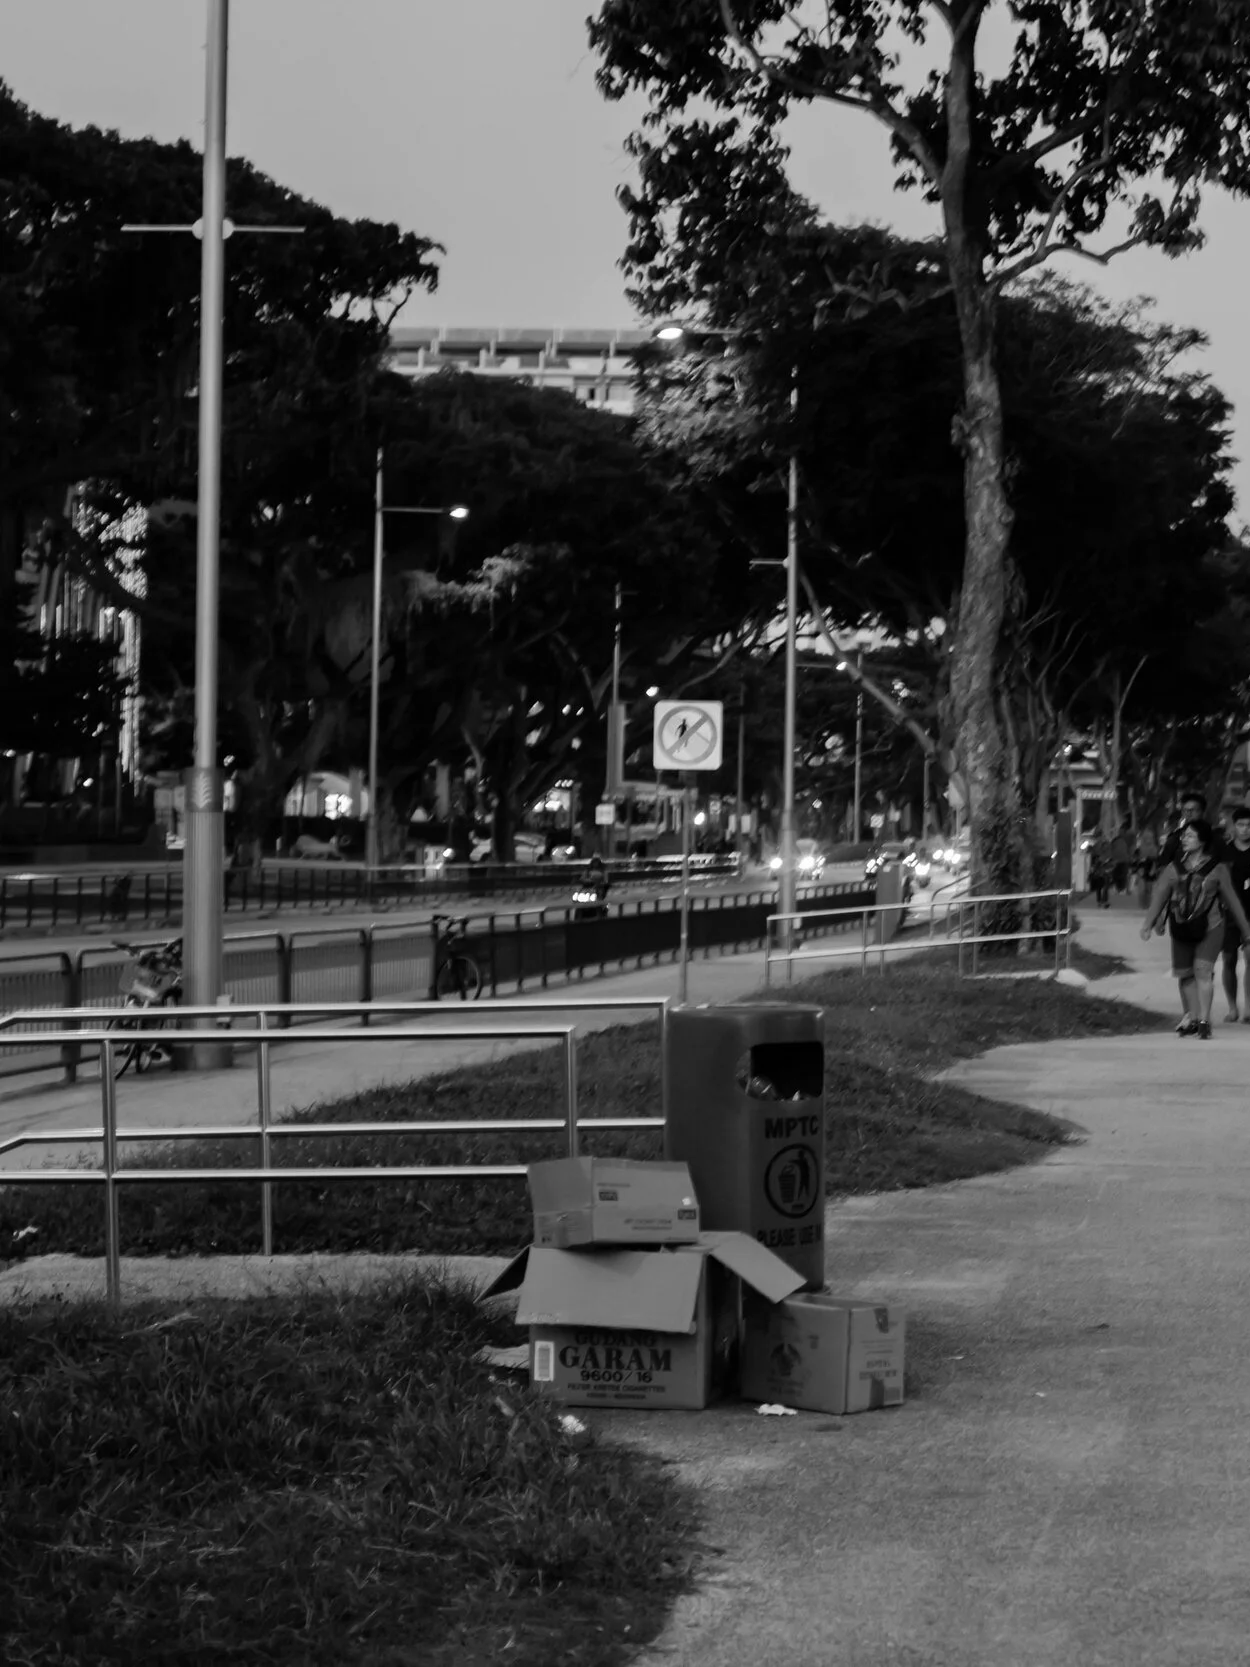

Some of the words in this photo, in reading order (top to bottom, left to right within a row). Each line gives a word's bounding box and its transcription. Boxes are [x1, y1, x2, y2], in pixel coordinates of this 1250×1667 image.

[765, 1116, 820, 1138] MPTC
[575, 1331, 658, 1348] GUDANG
[559, 1345, 672, 1371] GARAM
[580, 1370, 653, 1383] 9600/16
